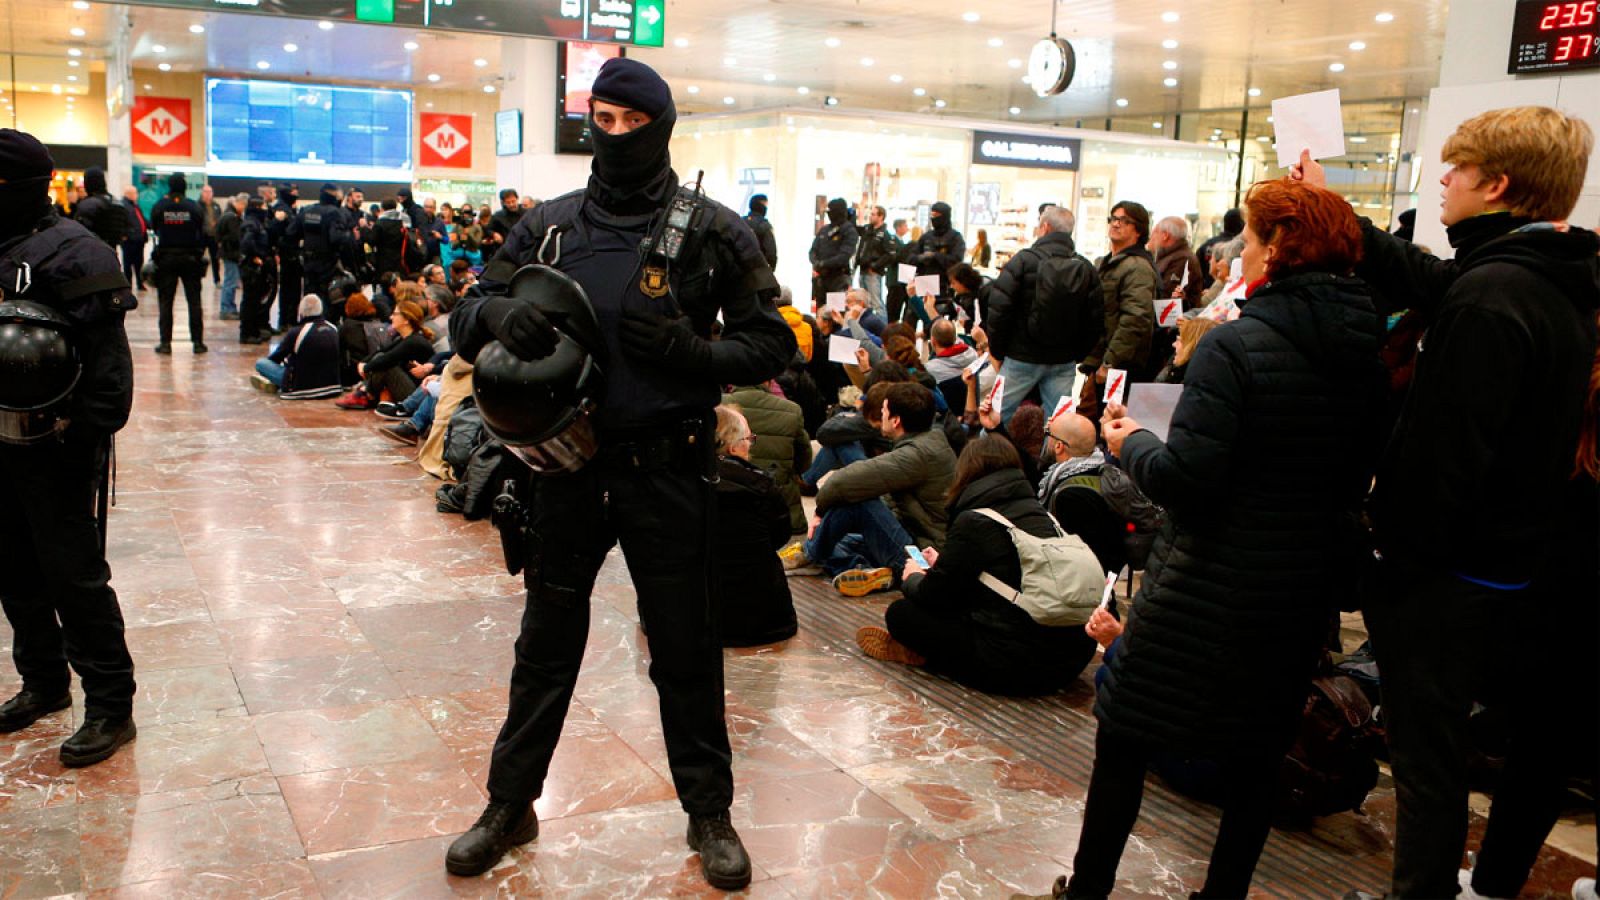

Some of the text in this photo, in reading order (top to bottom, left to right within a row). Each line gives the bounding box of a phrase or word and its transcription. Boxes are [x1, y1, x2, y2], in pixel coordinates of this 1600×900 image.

[151, 118, 171, 136] M
[437, 132, 455, 149] M
[478, 184, 496, 193] SHO
